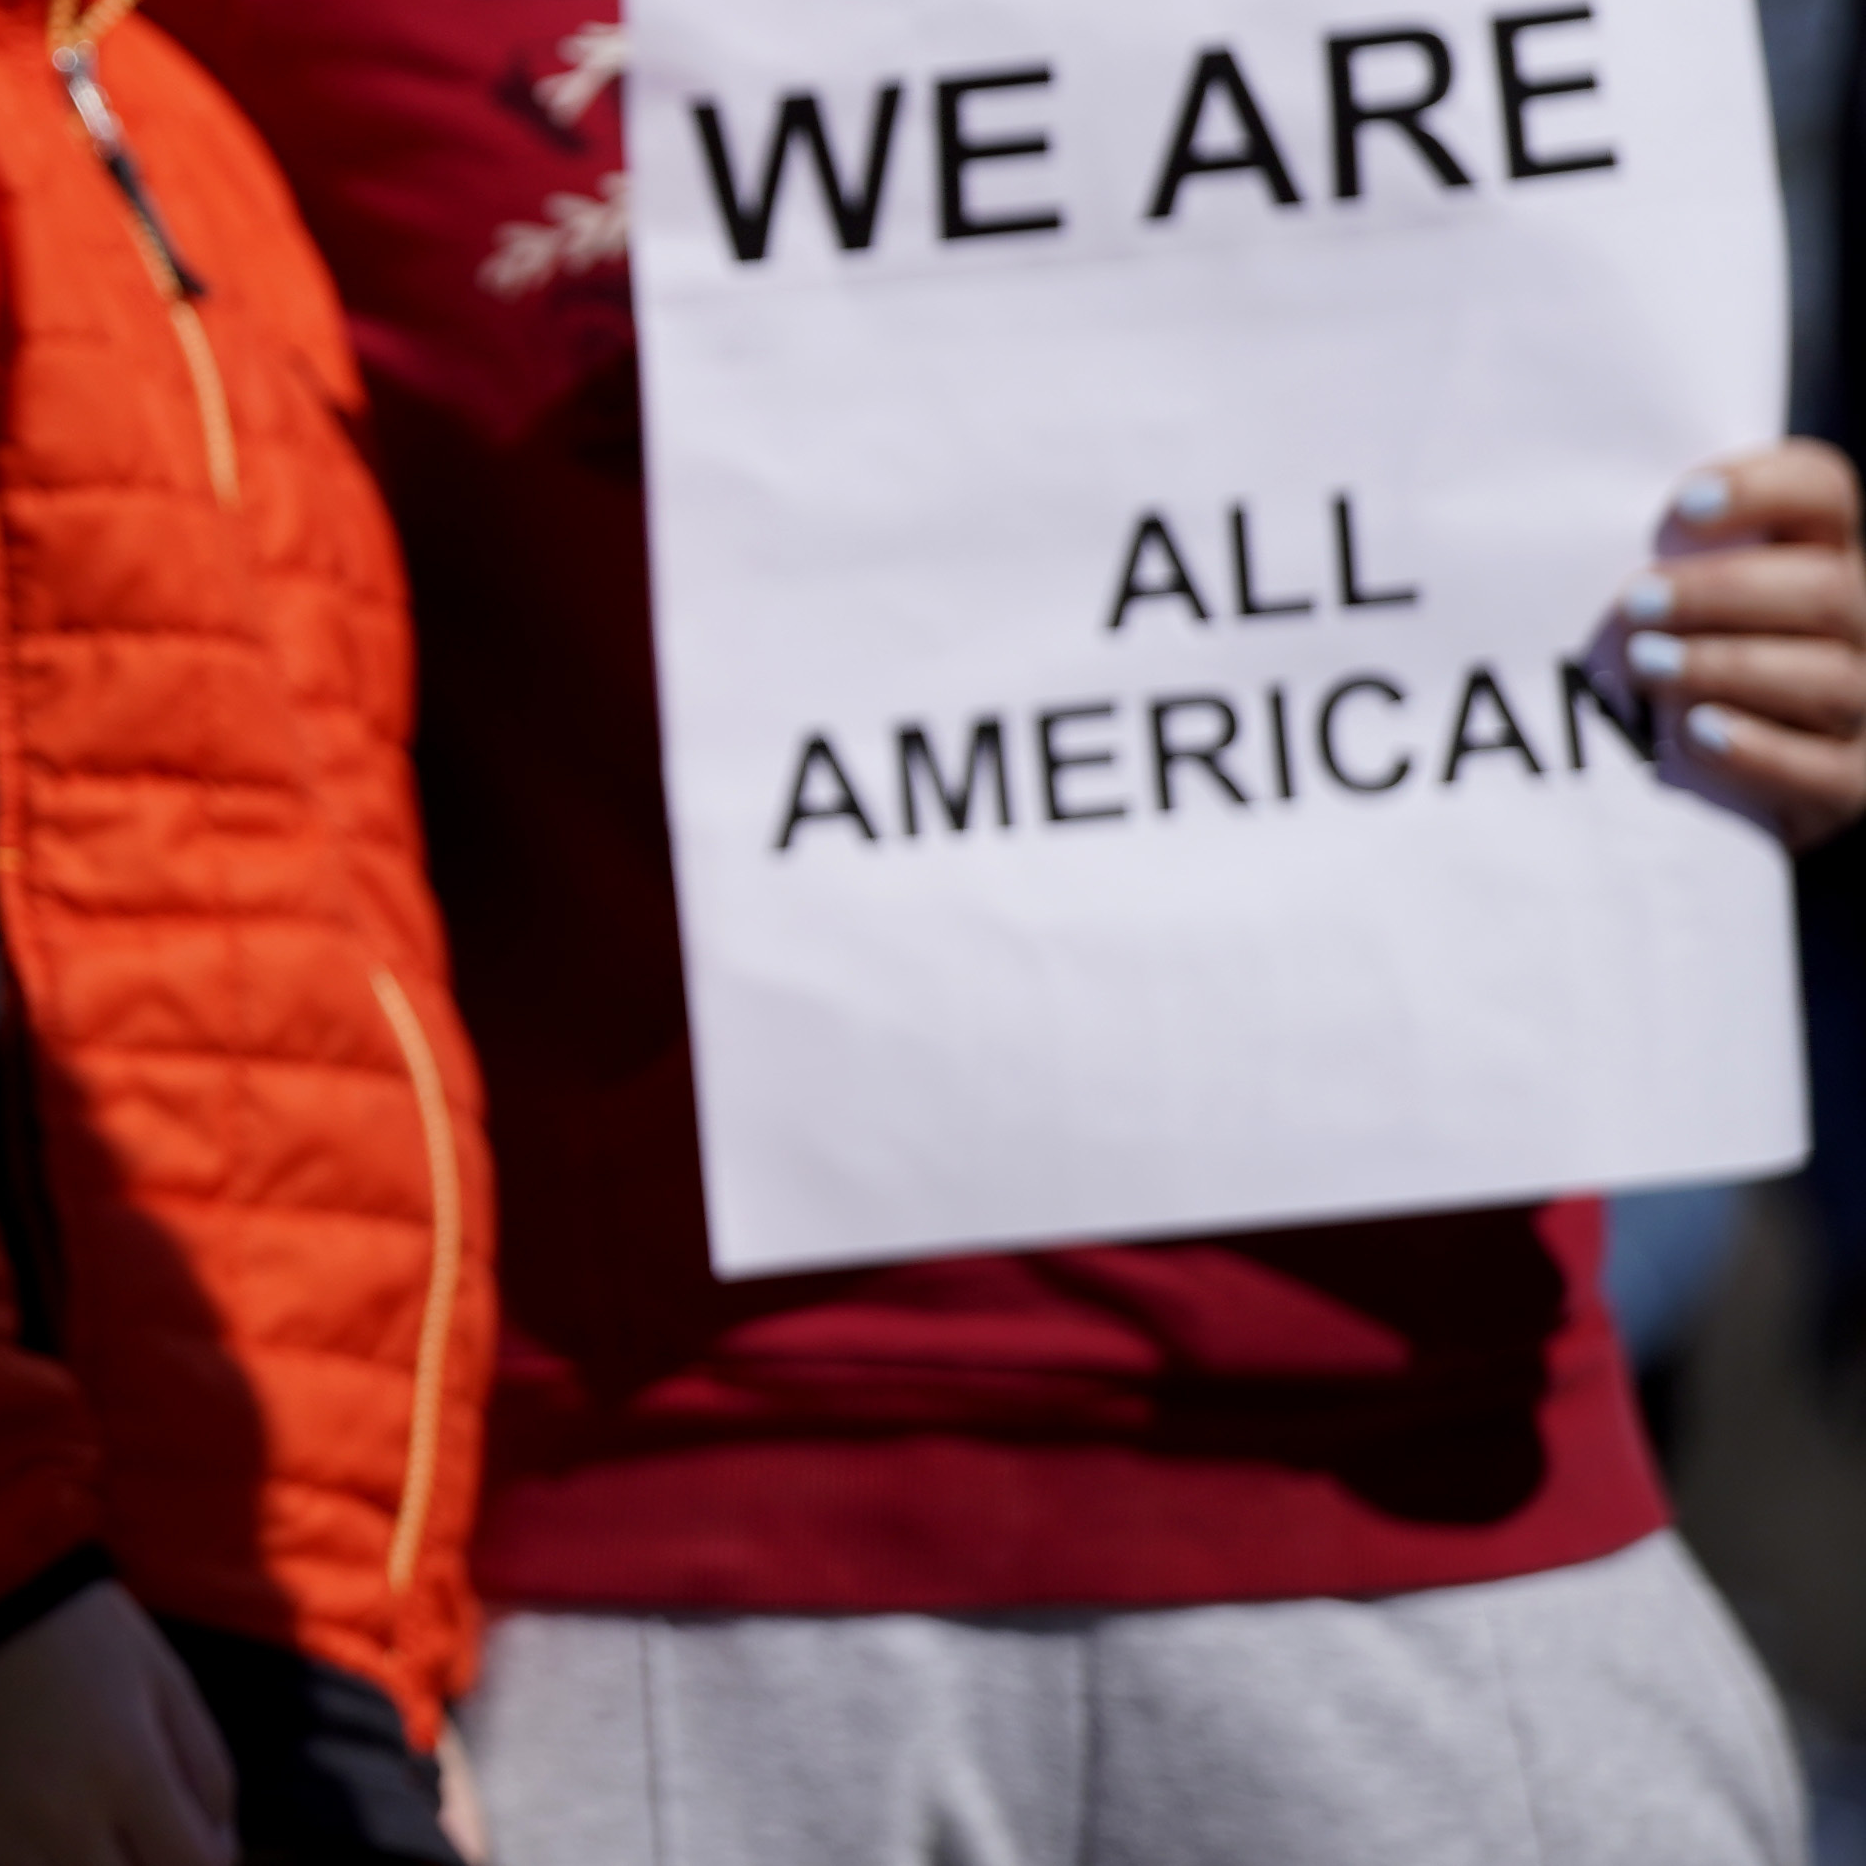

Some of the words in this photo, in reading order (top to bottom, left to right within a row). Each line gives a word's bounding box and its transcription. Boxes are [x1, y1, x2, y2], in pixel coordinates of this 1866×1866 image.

[687, 62, 1067, 265] WE
[1143, 2, 1619, 224] ARE
[1106, 493, 1419, 632] ALL
[775, 656, 1658, 851] AMERICAN
